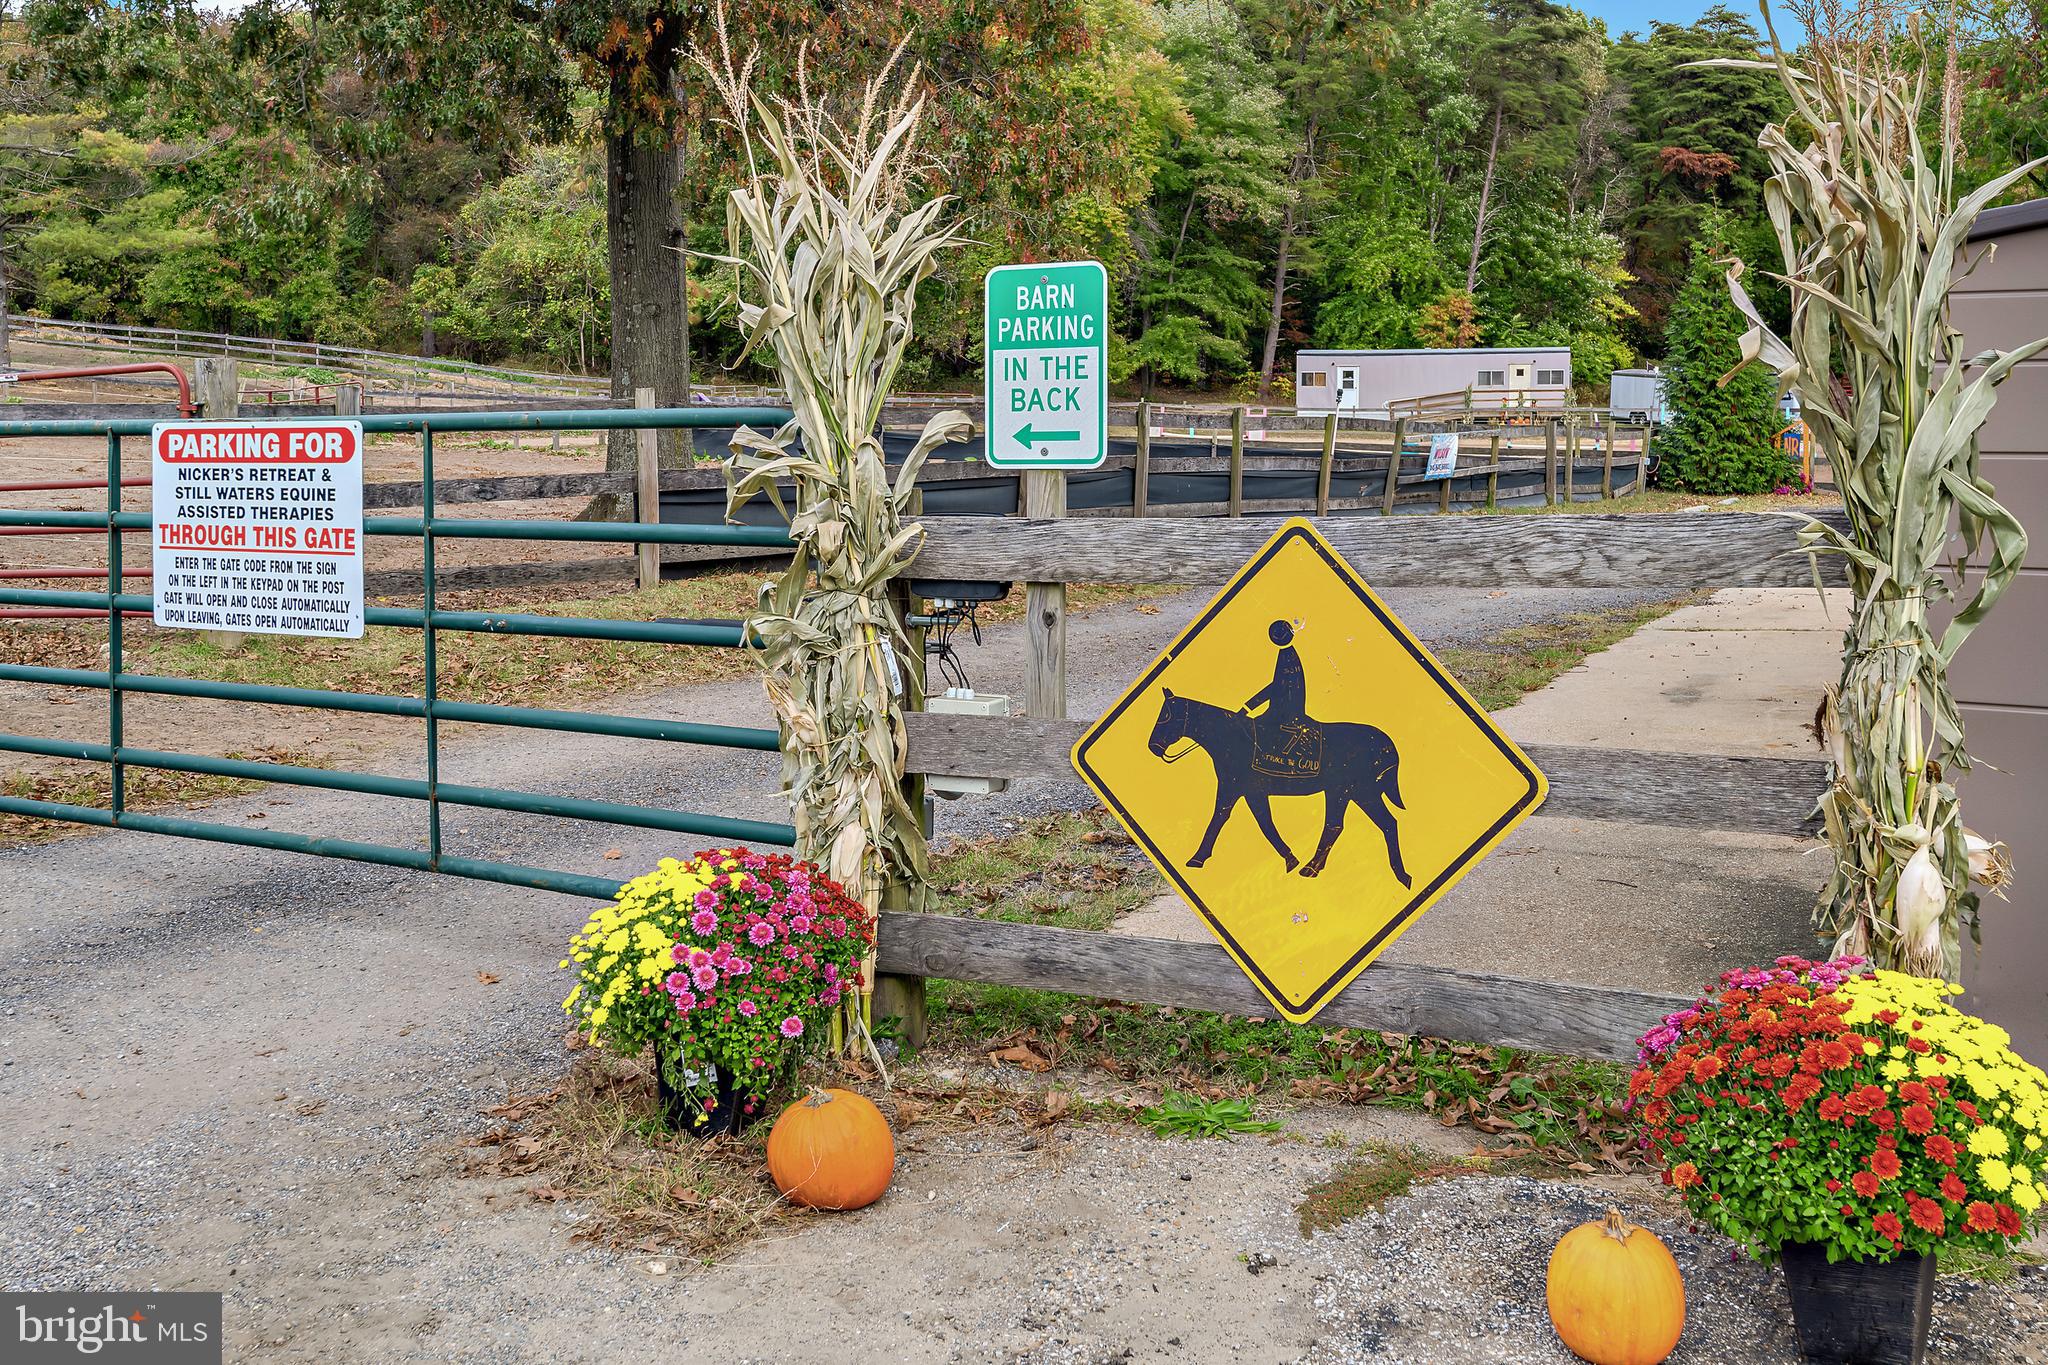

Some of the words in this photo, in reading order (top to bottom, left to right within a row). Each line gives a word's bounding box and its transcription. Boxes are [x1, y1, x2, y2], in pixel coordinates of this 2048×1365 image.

[1016, 283, 1075, 311] BARN
[998, 314, 1094, 342] PARKING
[1004, 357, 1028, 381] IN
[1039, 355, 1089, 381] THE
[1011, 387, 1081, 412] BACK
[168, 433, 280, 459] PARKING
[289, 432, 343, 459] FOR
[178, 468, 244, 481] NICKER'S
[249, 468, 316, 482] RETREAT
[321, 468, 332, 482] &
[175, 486, 212, 500] STILL
[216, 487, 275, 501] WATERS
[280, 488, 336, 502] EQUINE
[177, 505, 246, 519] ASSISTED
[250, 506, 334, 521] THERAPIES
[159, 523, 246, 546] THROUGH
[253, 526, 297, 548] THIS
[304, 527, 356, 550] GATE
[175, 556, 199, 570] ENTER
[202, 557, 217, 571] THE
[220, 558, 241, 572] GATE
[244, 559, 266, 573] CODE
[270, 560, 293, 574] FROM
[296, 561, 313, 574] THE
[316, 561, 337, 576] SIGN
[168, 573, 179, 587] ON
[182, 574, 196, 588] THE
[200, 575, 218, 589] LEFT
[220, 576, 229, 589] IN
[232, 577, 247, 590] THE
[250, 578, 284, 592] KEYPAD
[287, 579, 299, 593] ON
[302, 580, 319, 593] THE
[322, 580, 345, 595] POST
[164, 591, 183, 605] GATE
[185, 592, 203, 606] WILL
[206, 593, 228, 608] OPEN
[230, 594, 248, 608] AND
[250, 595, 278, 610] CLOSE
[281, 597, 351, 614] AUTOMATICALLY
[165, 609, 185, 622] UPON
[187, 610, 222, 627] LEAVING,
[225, 612, 252, 627] GATES
[255, 614, 277, 628] OPEN
[280, 615, 350, 633] AUTOMATICALLY
